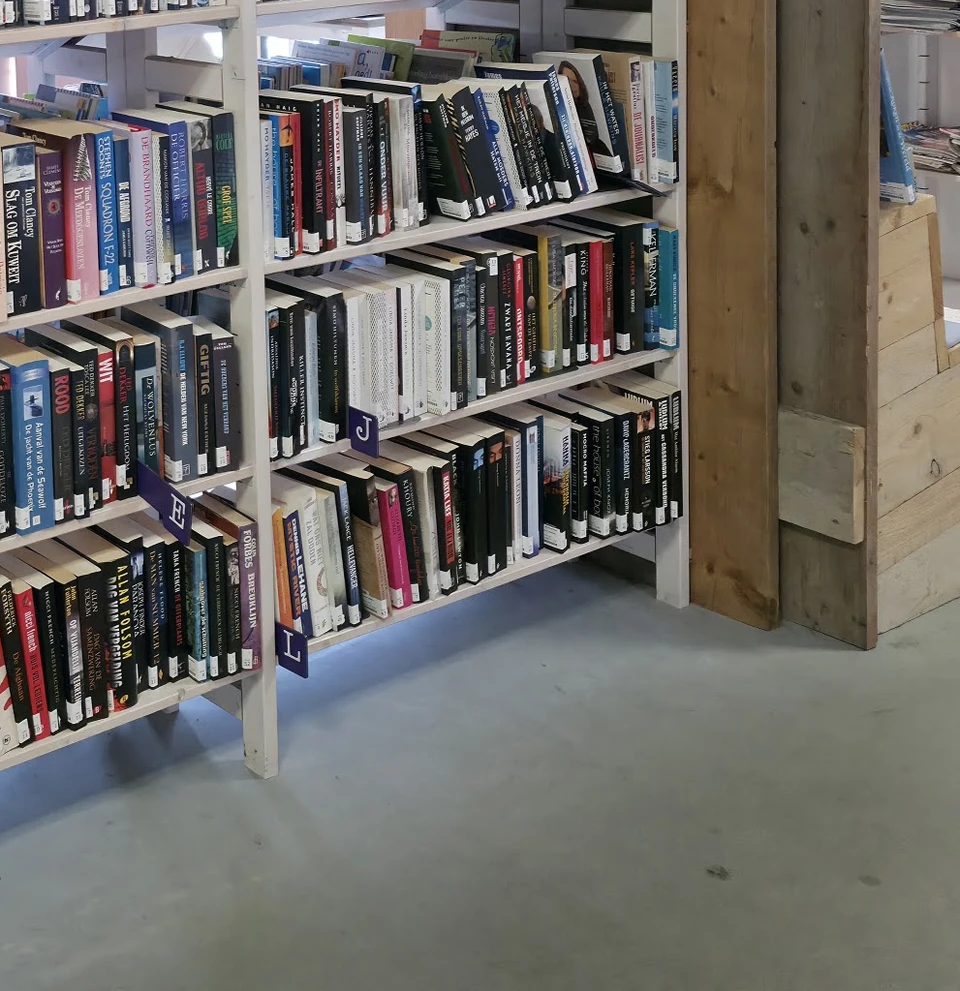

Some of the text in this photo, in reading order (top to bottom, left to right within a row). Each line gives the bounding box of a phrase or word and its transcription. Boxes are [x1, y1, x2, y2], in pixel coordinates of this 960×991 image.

[602, 81, 620, 135] IN HET WATER
[635, 111, 645, 165] DE JOURNALIST
[315, 169, 324, 214] INFILTRANT
[381, 180, 389, 213] VUUR
[24, 186, 37, 238] Tom Clancy
[101, 182, 115, 266] SQUADRON F-22
[5, 189, 23, 284] SLAG OM KUWEIT
[581, 250, 589, 276] KING
[99, 357, 114, 382] WIT
[200, 343, 210, 396] GIFTIG
[54, 375, 71, 416] ROOD
[36, 422, 45, 449] Aanval
[356, 415, 373, 442] J
[36, 466, 45, 476] de
[37, 477, 46, 509] Seawolf
[169, 492, 186, 530] E
[342, 496, 350, 514] JACK
[403, 478, 415, 518] KHOURY
[242, 529, 255, 569] FORBES
[292, 518, 309, 612] DENNIS LEHANE
[0, 587, 13, 635] FORSYTH
[6, 589, 17, 628] FREDERICK
[116, 564, 134, 660] ALLAN FOLSOM
[247, 572, 258, 629] BREUKLIJN
[283, 628, 301, 662] L
